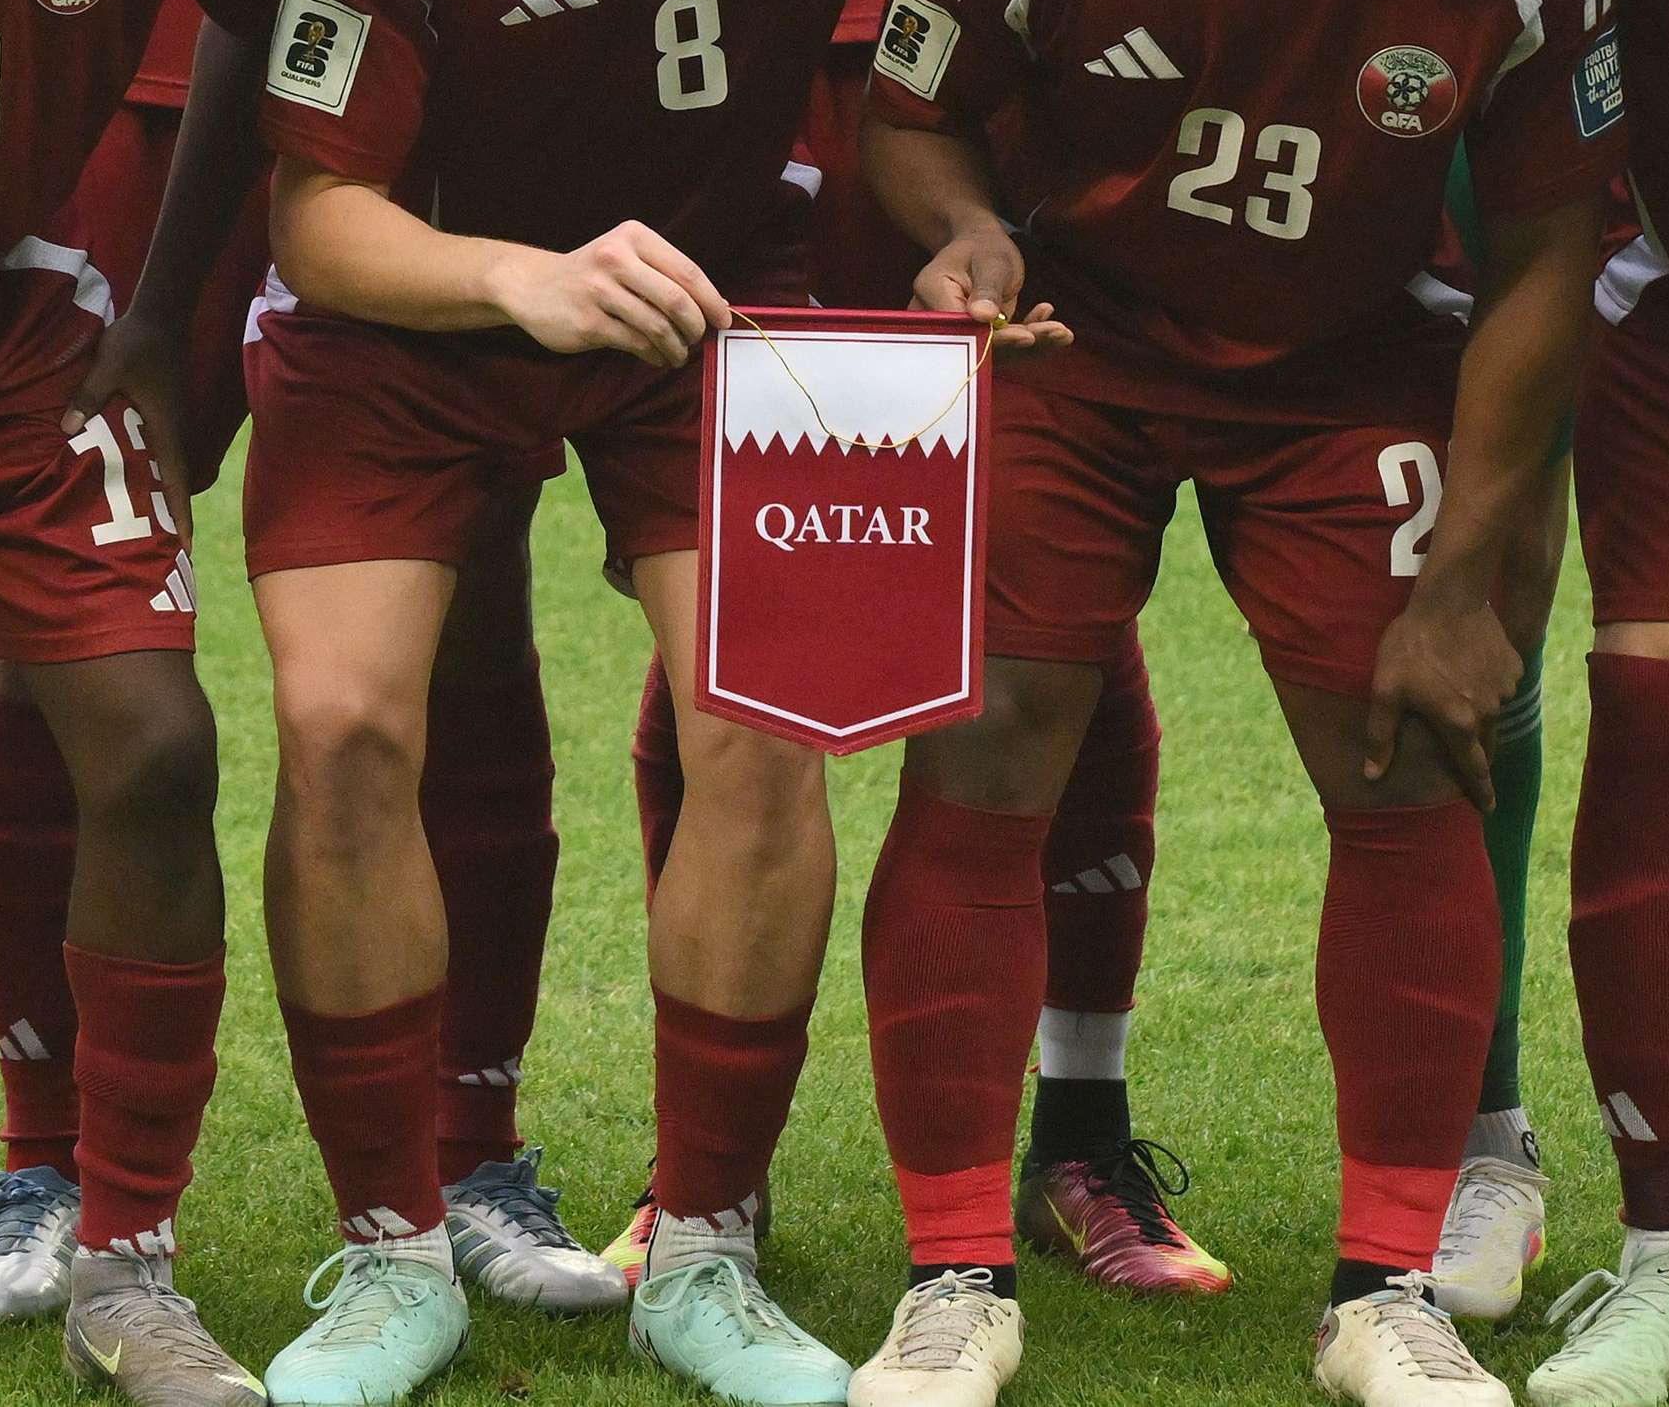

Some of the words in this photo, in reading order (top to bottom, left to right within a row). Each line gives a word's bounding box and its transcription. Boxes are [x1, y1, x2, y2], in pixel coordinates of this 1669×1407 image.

[295, 60, 317, 72] FIFA
[280, 70, 322, 89] QUALIFIERS
[1380, 111, 1423, 132] QFA
[1166, 107, 1322, 241] 23
[754, 502, 934, 552] QATAR
